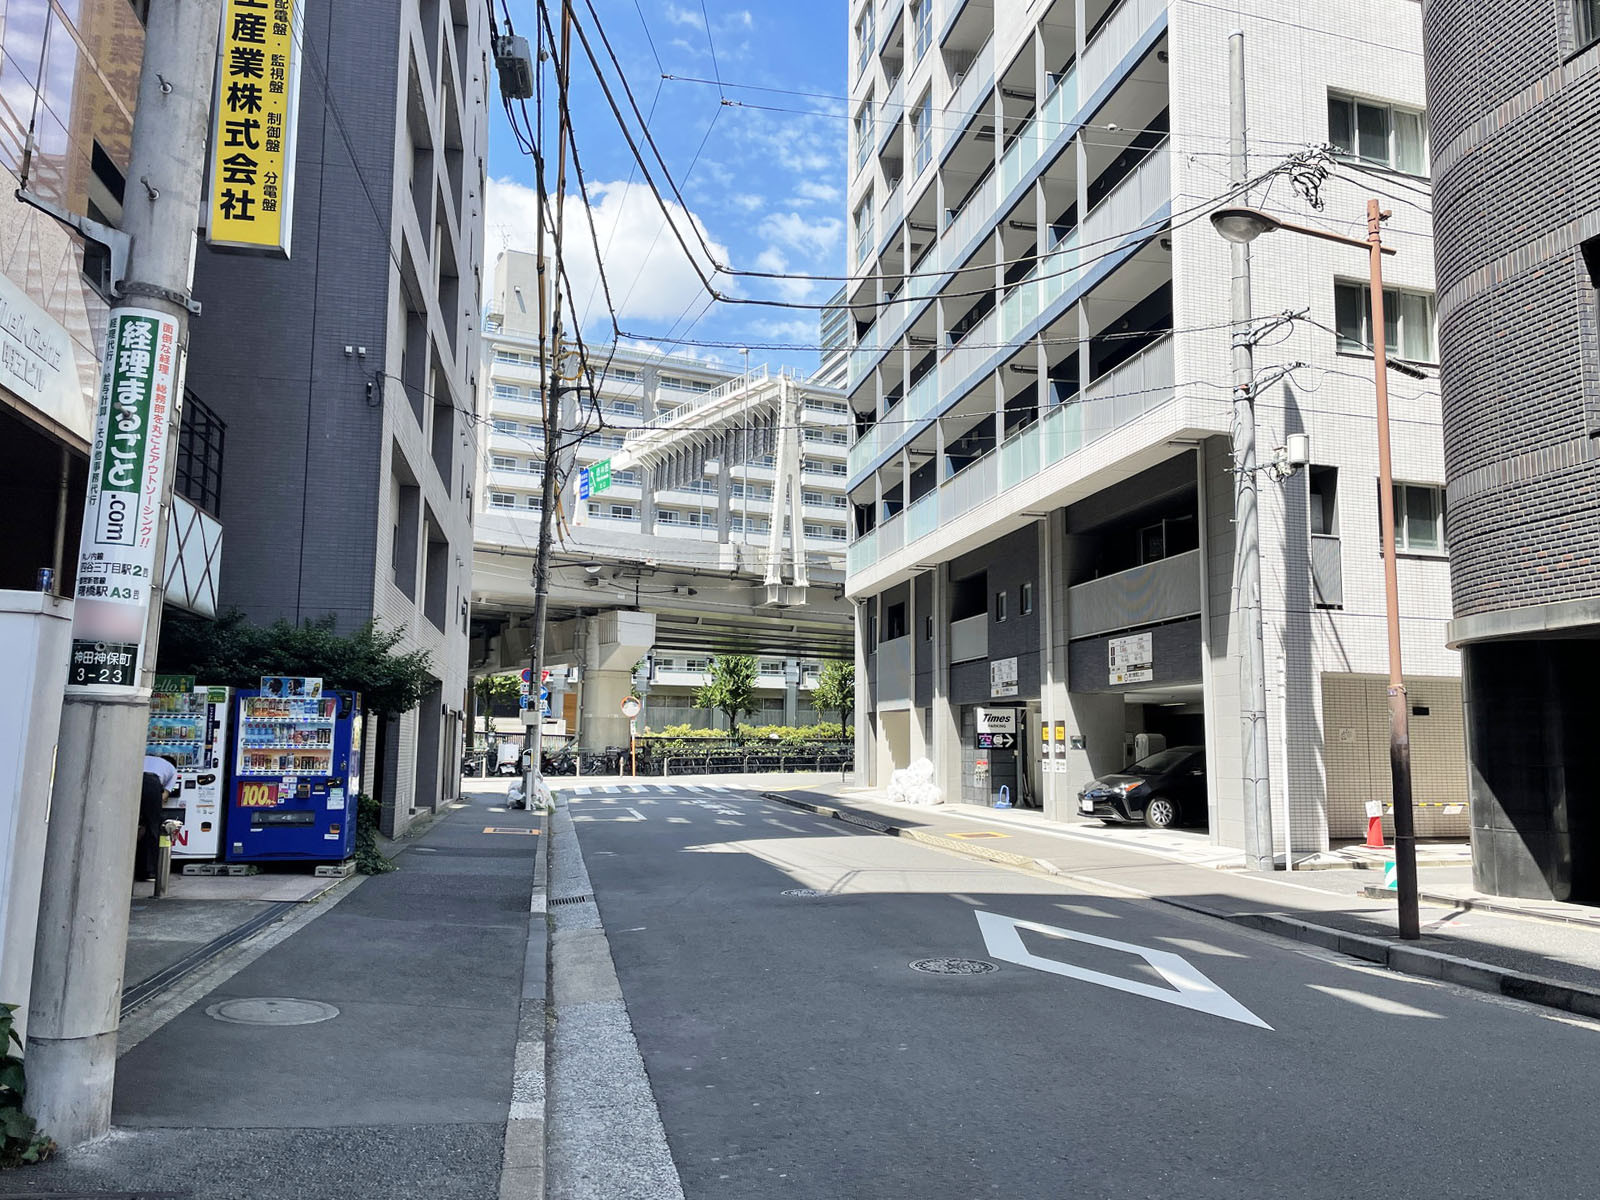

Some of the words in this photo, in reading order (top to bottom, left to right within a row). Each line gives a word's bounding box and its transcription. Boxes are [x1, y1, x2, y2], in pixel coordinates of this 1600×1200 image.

[220, 0, 268, 222] 産業株式会社
[74, 650, 132, 667] 神田神保町
[76, 667, 123, 683] 3-23
[152, 677, 180, 692] ello.
[982, 713, 1011, 723] Times
